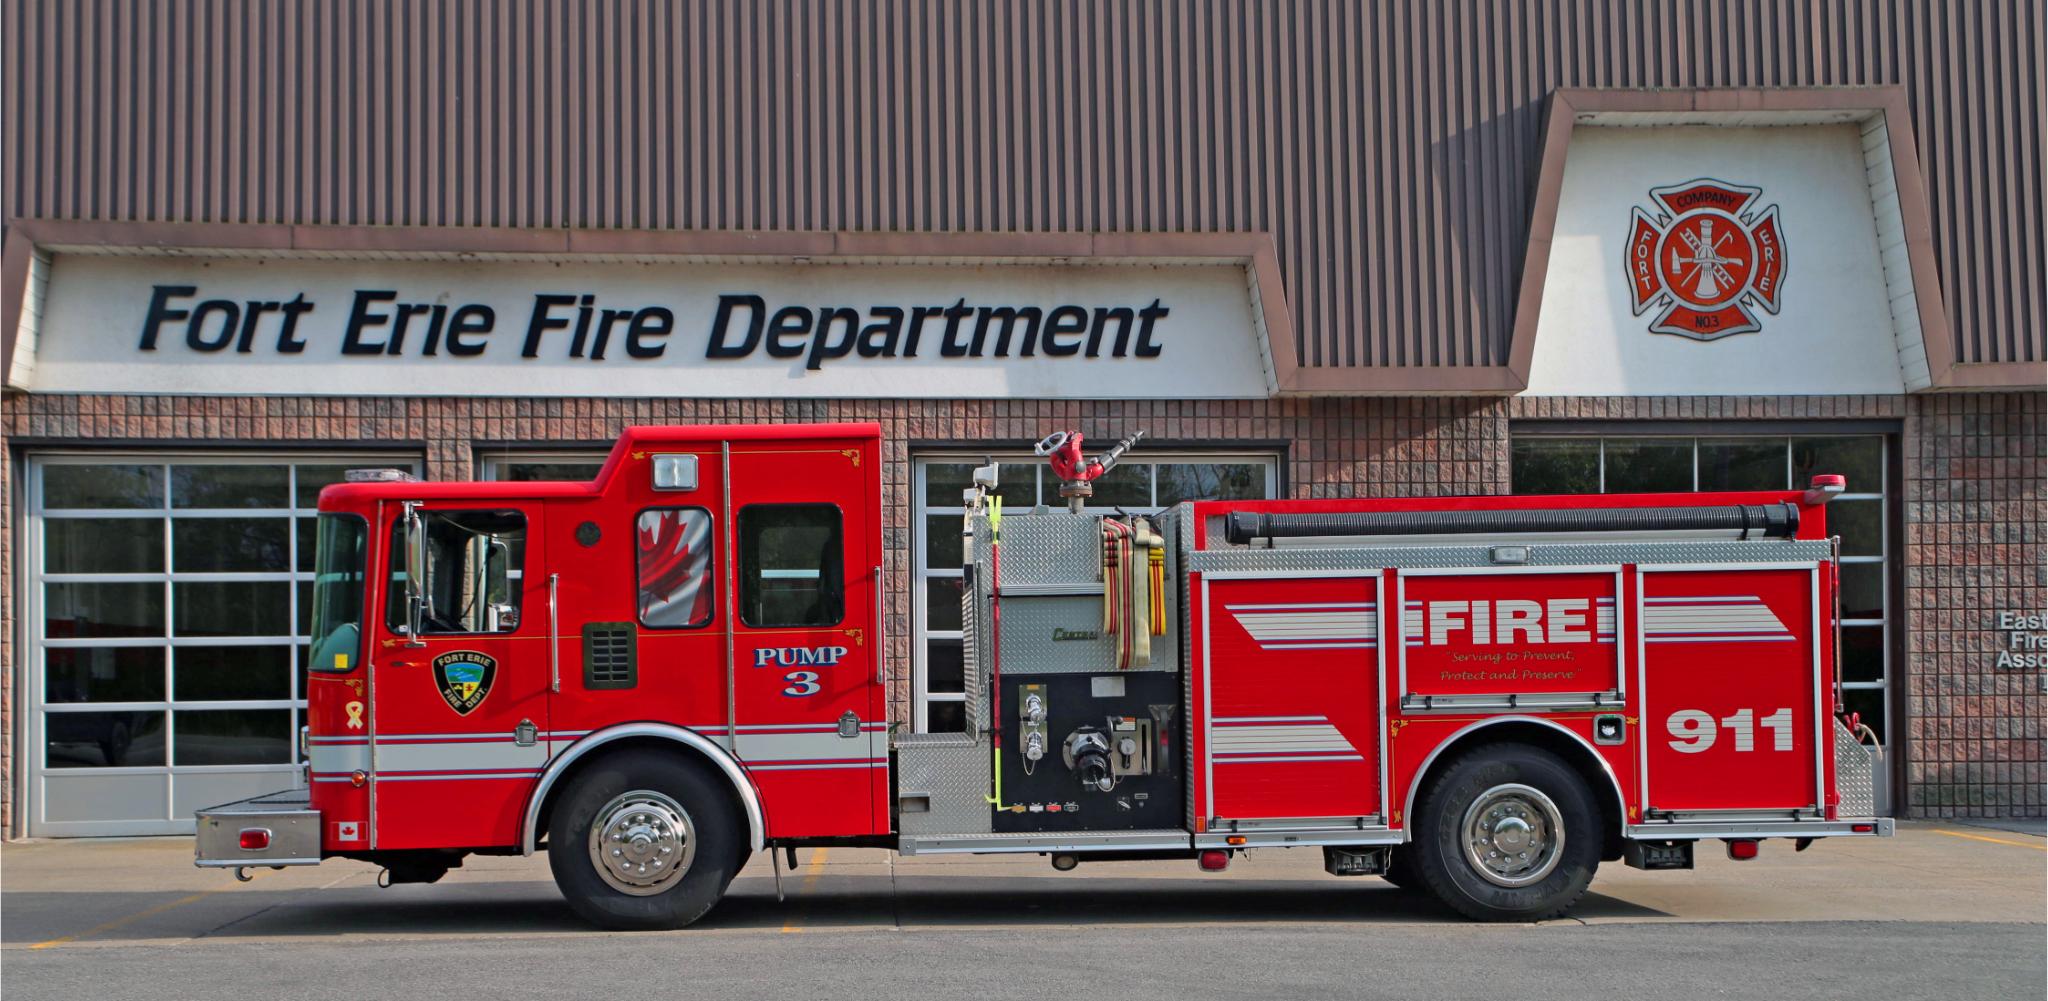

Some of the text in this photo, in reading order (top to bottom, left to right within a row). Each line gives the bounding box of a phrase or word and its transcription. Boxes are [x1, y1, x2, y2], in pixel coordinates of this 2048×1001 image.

[1676, 191, 1736, 207] COMPANY
[1637, 230, 1652, 291] FORT
[1758, 229, 1775, 292] ERIE
[139, 285, 1170, 370] Fort Erie Fire Department
[1429, 599, 1591, 645] FIRE
[438, 653, 491, 666] FORT ERIE
[753, 646, 848, 668] PUMP
[1506, 652, 1519, 661] to
[782, 671, 821, 698] 3
[1440, 670, 1487, 681] Protect
[1489, 669, 1518, 680] and
[444, 688, 463, 708] FIRE
[1666, 708, 1794, 754] 911
